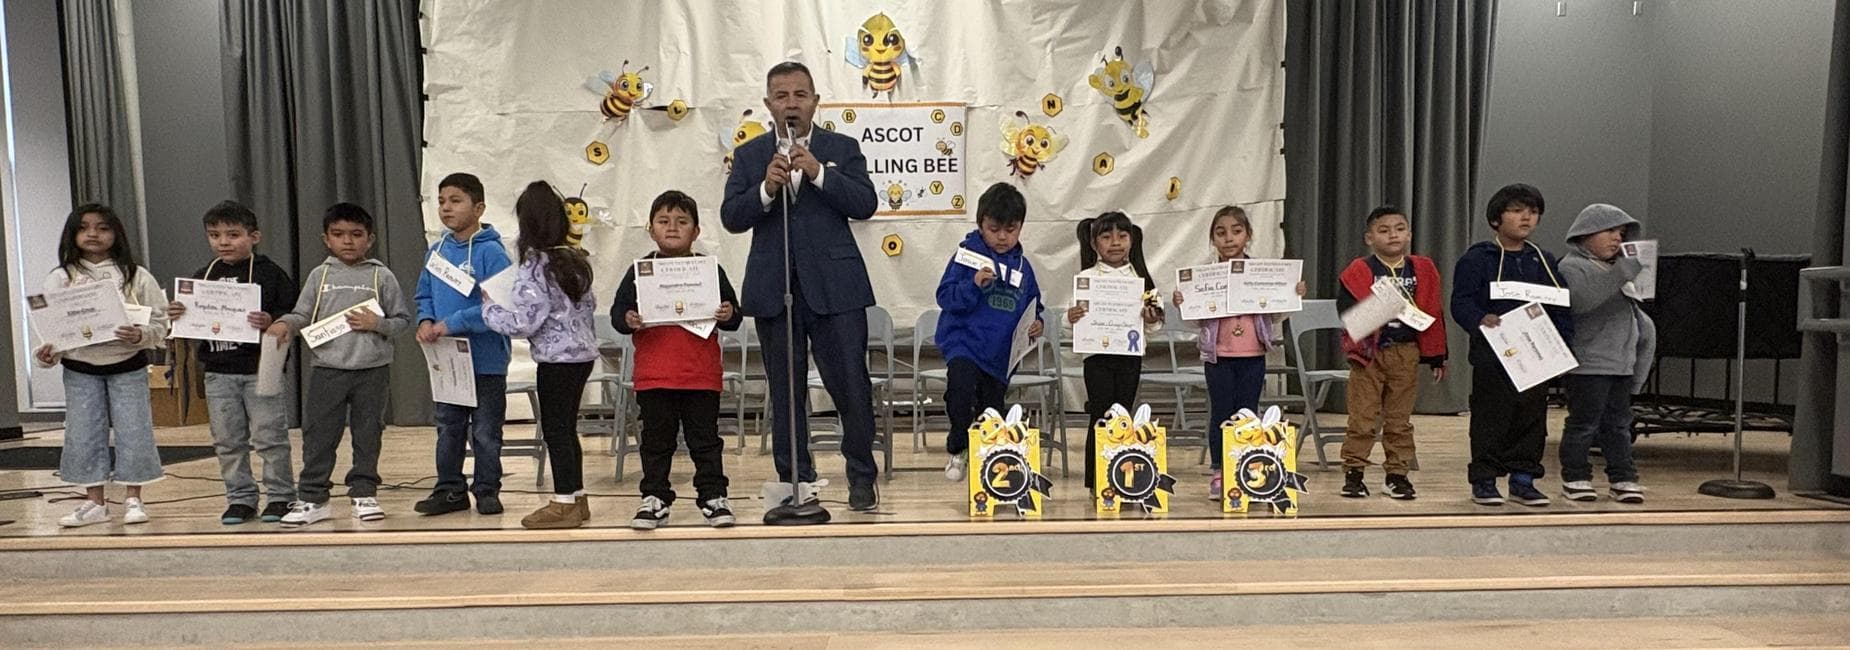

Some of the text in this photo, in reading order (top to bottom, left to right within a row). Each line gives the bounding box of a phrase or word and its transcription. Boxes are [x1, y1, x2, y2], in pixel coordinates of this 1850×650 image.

[1047, 100, 1056, 110] N
[673, 106, 682, 115] L
[845, 112, 853, 121] B
[934, 112, 943, 121] C
[953, 125, 962, 134] D
[861, 127, 924, 143] ASCOT
[593, 146, 602, 157] S
[924, 157, 958, 173] BEE
[1099, 159, 1108, 169] A
[932, 183, 941, 193] Y
[953, 197, 961, 207] Z
